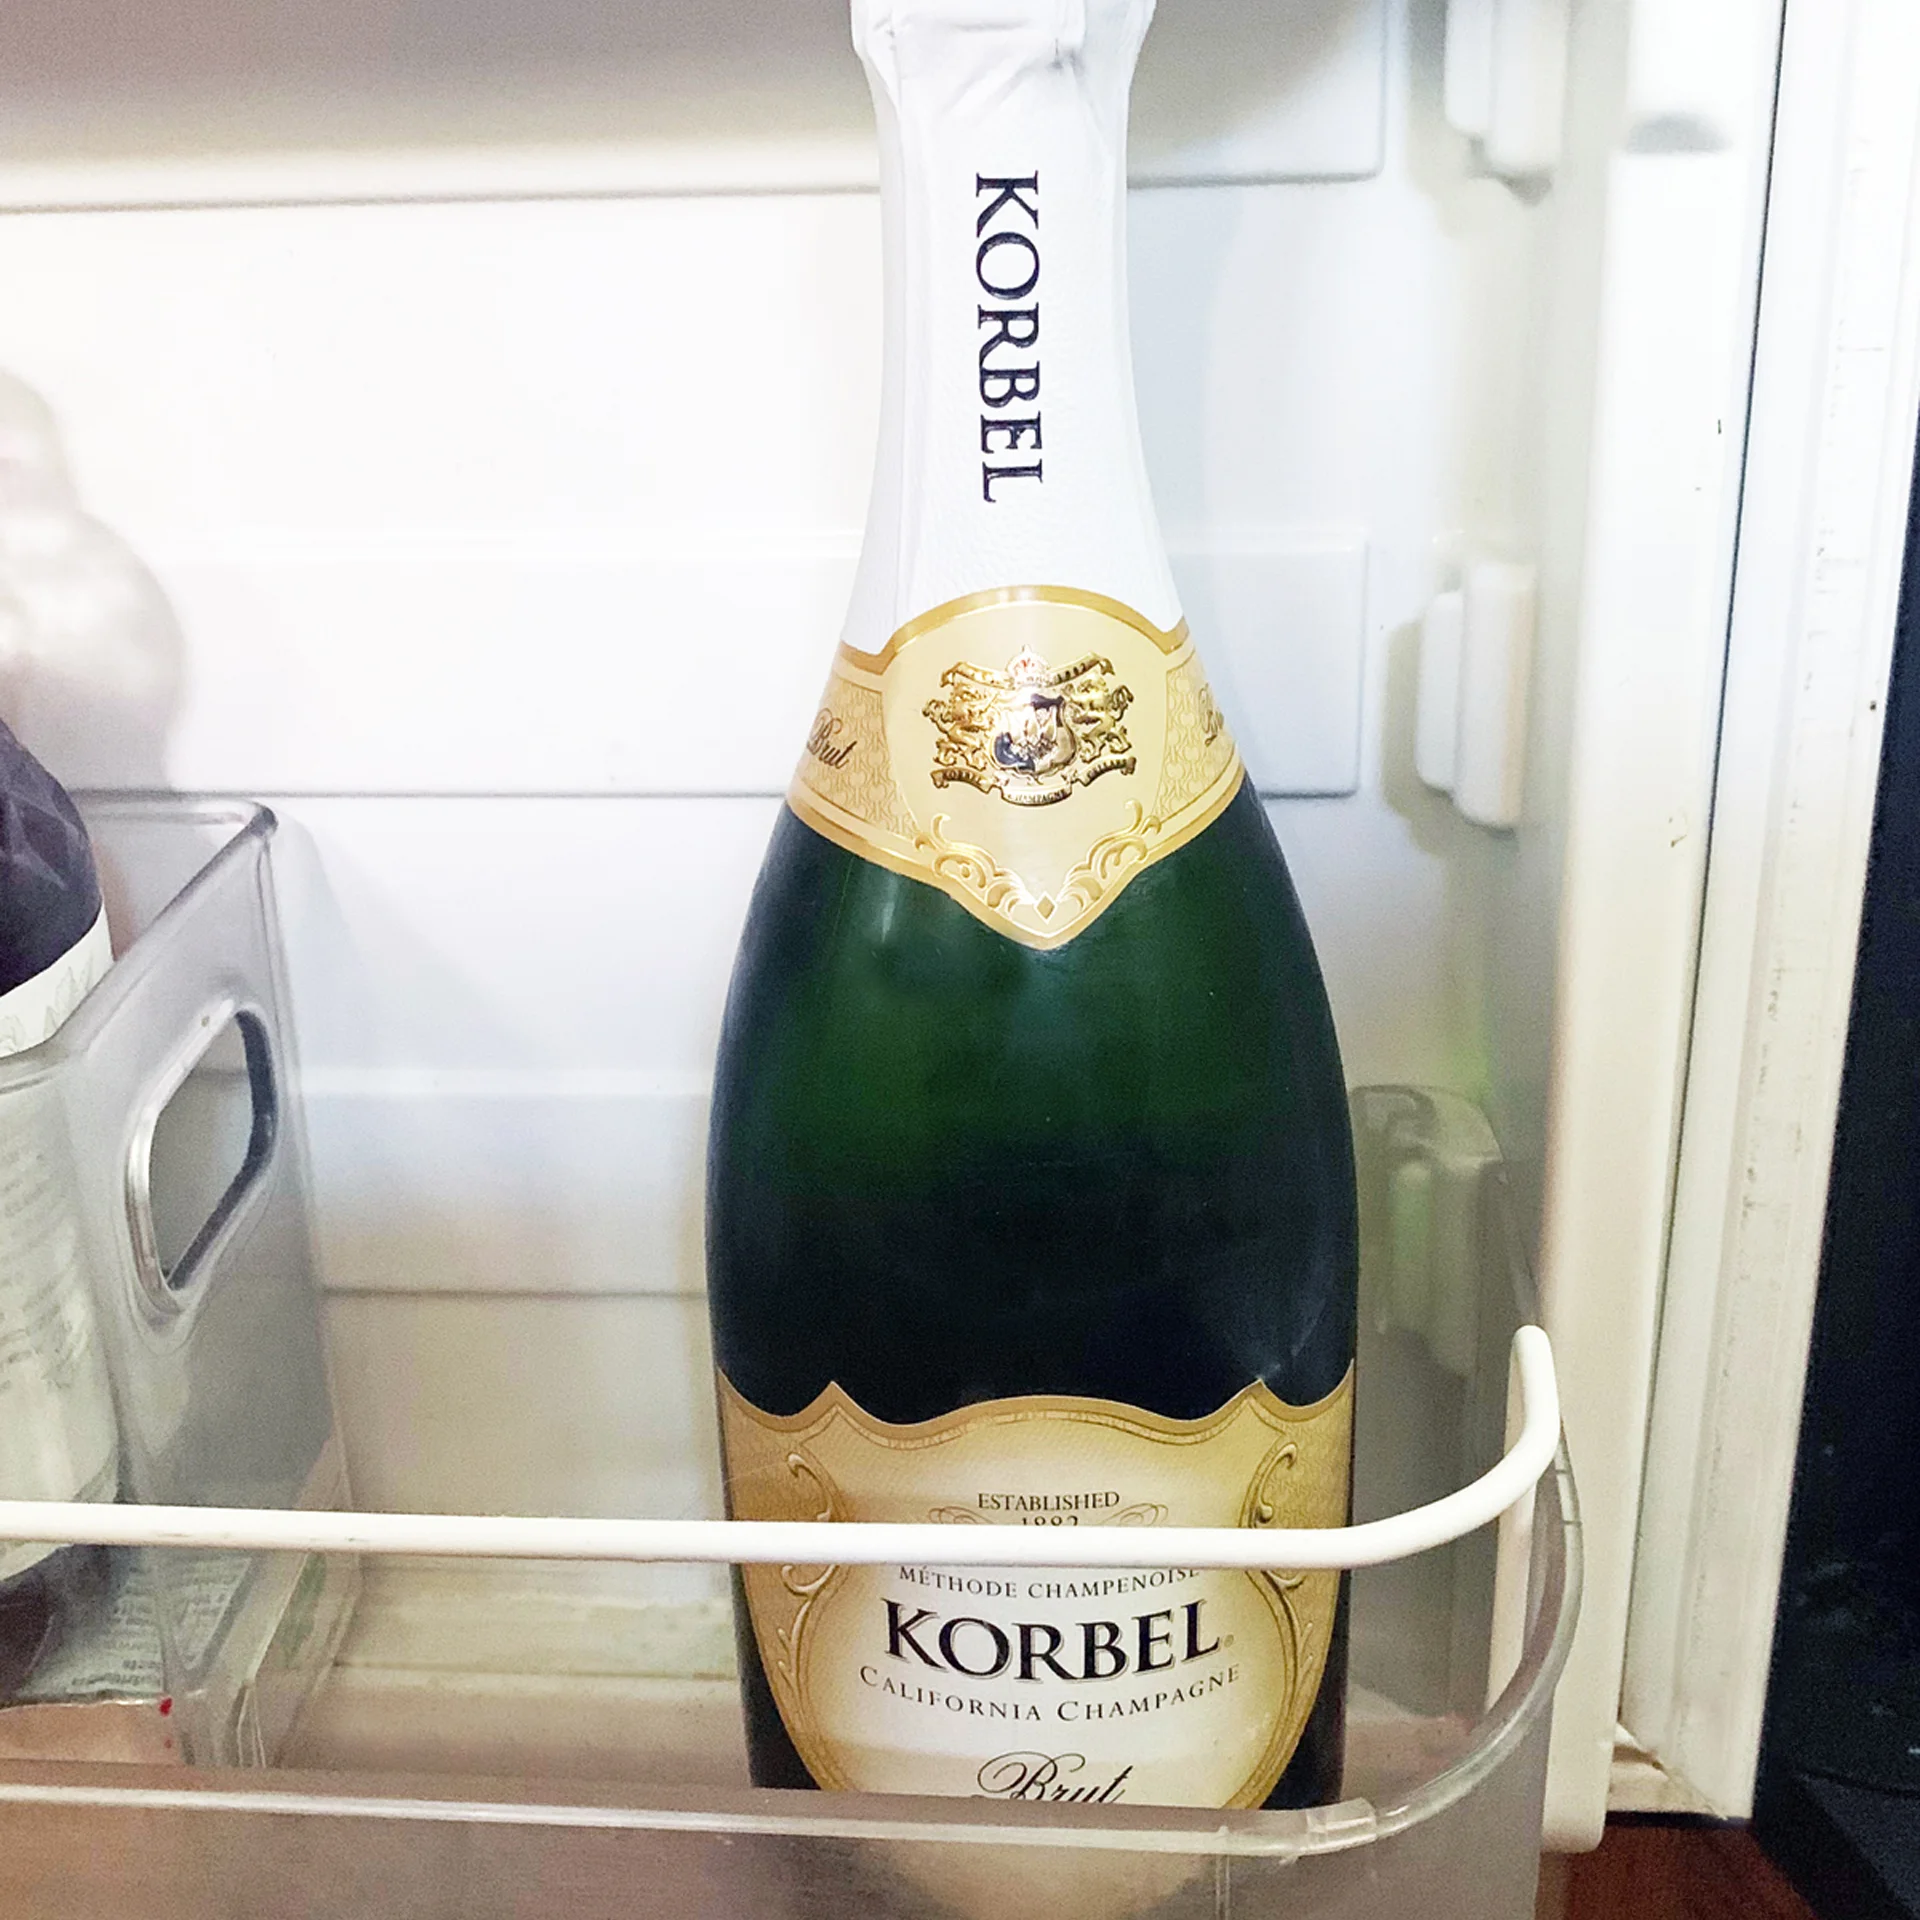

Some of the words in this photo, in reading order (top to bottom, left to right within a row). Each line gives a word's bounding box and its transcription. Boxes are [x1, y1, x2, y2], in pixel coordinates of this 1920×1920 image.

[975, 170, 1043, 503] KORBEL
[806, 707, 858, 770] Brut
[978, 1491, 1120, 1511] ESTABLISHED
[899, 1565, 1018, 1598] MÉTHODE
[880, 1597, 1221, 1684] KORBEL
[860, 1665, 1042, 1721] CALIFORNIA
[1057, 1663, 1240, 1722] CHAMPAGNE
[977, 1751, 1133, 1803] Brut
